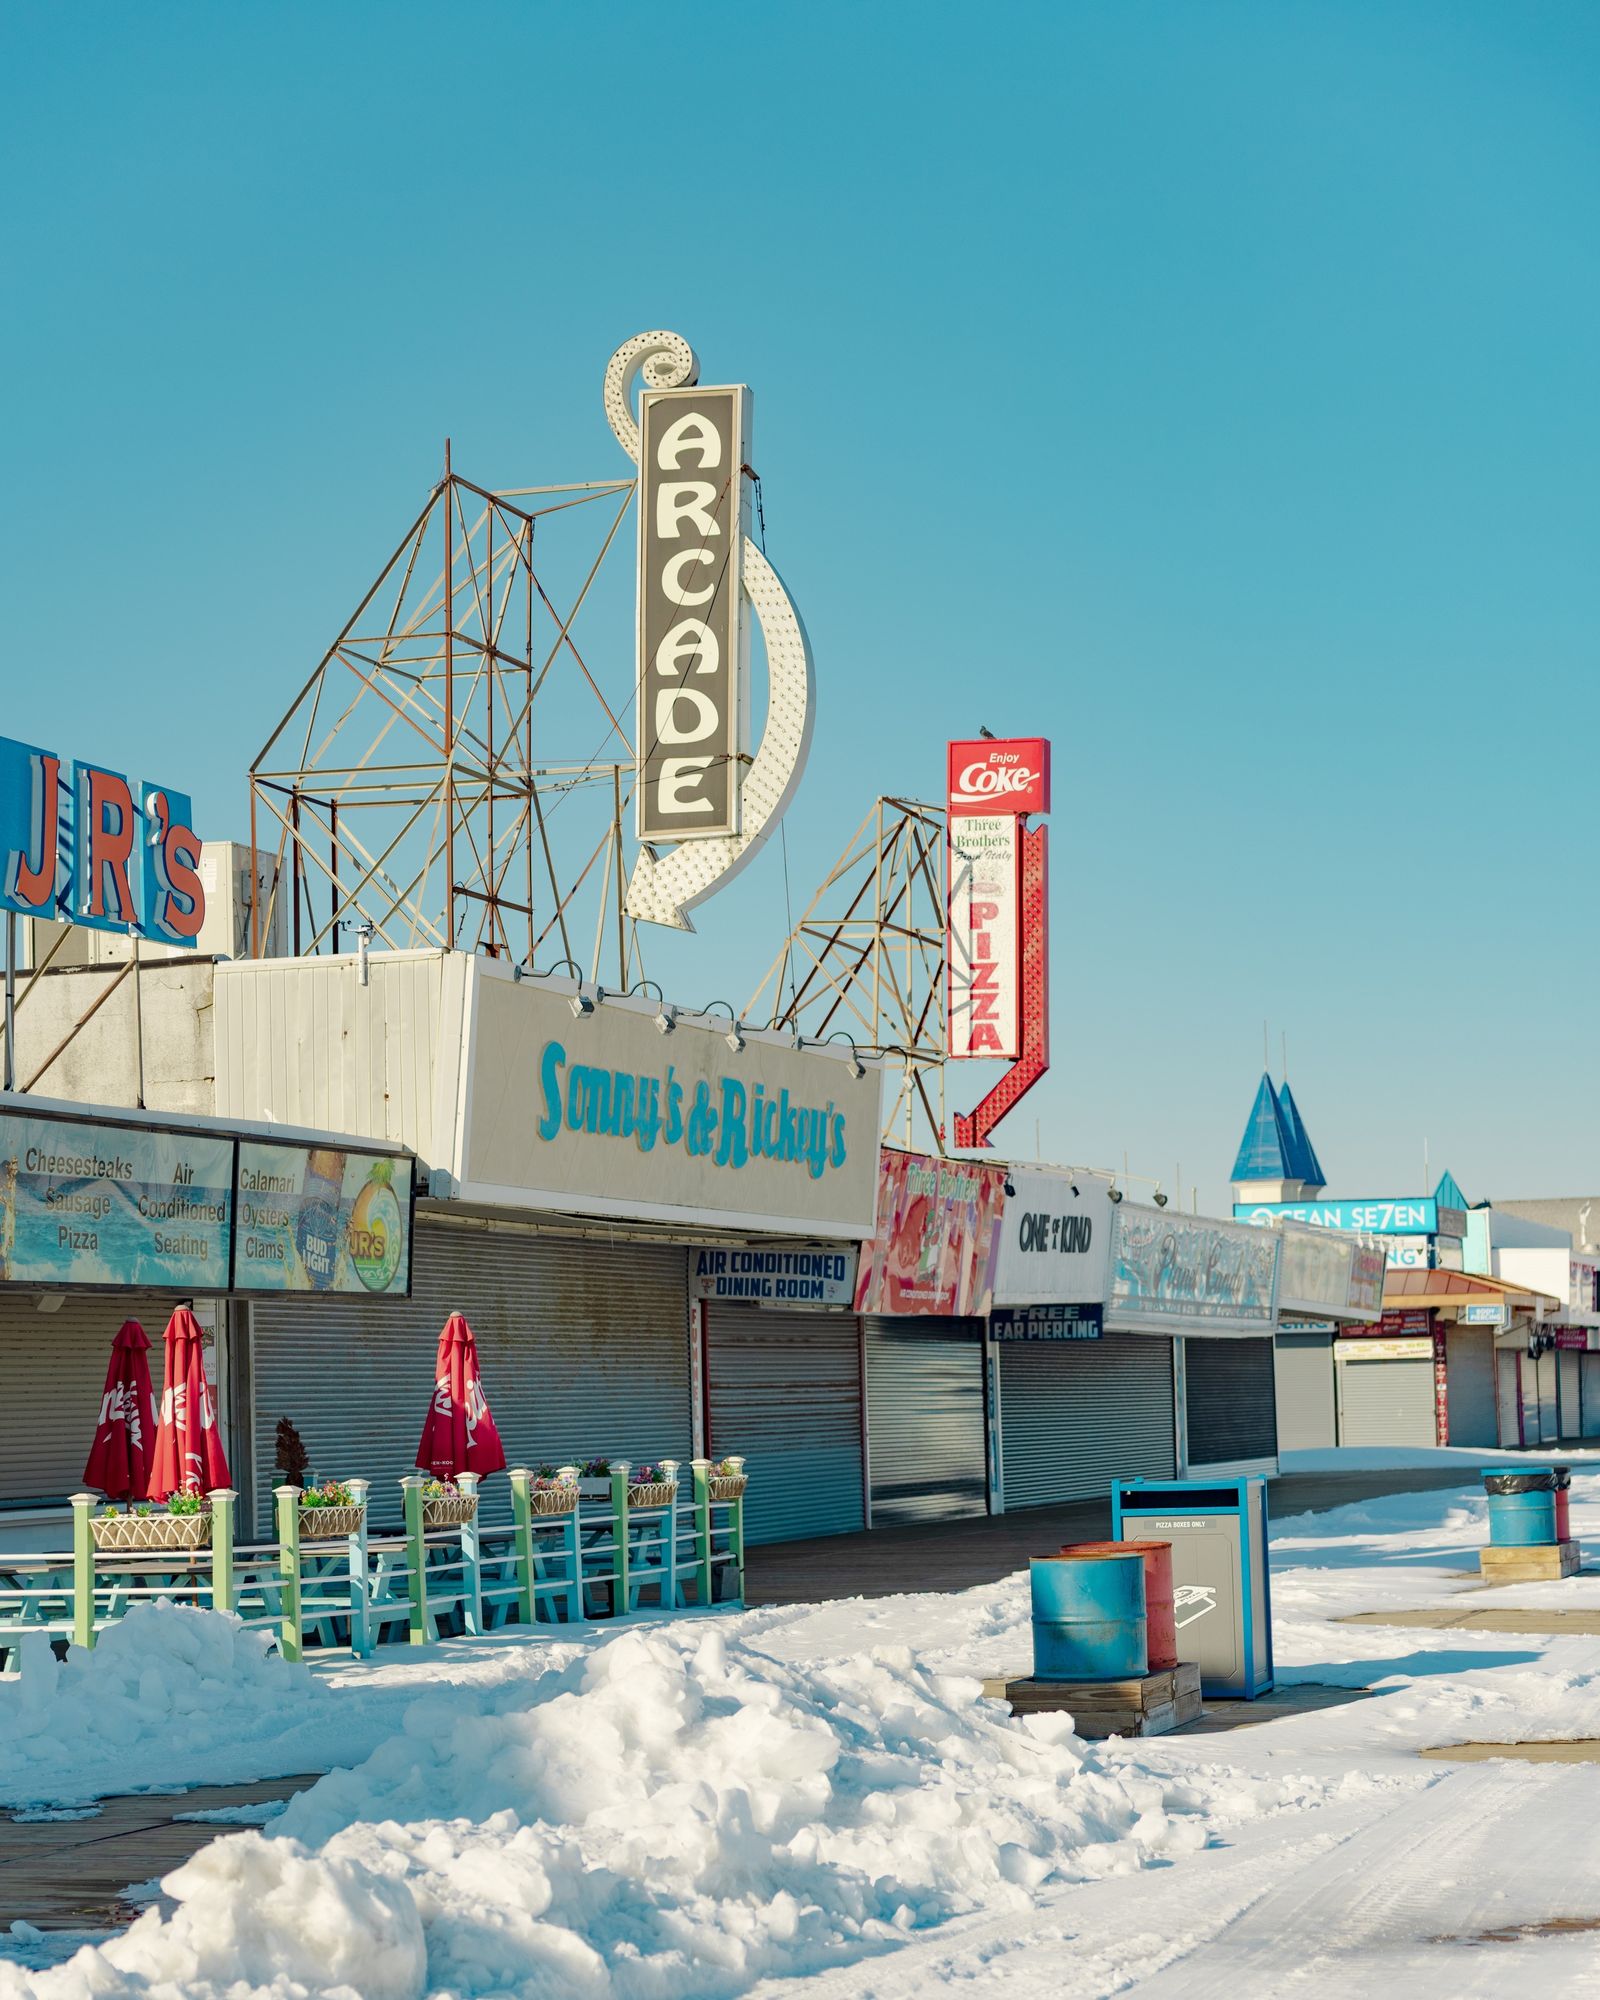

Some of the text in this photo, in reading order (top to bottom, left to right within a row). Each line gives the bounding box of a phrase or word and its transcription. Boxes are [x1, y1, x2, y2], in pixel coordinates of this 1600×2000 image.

[656, 411, 722, 815] ARCADE
[989, 753, 1020, 764] Enjoy
[959, 762, 1040, 793] Coke
[965, 818, 1001, 831] Three
[957, 834, 1010, 848] Brothers
[966, 902, 1003, 1051] PIZZA
[537, 1040, 846, 1180] Sonny's & Rickey's
[25, 1147, 133, 1179] Cheesesteaks
[173, 1162, 194, 1184] Air
[240, 1168, 295, 1193] Calamari
[907, 1163, 936, 1197] Three
[45, 1186, 111, 1219] Sausage
[138, 1194, 226, 1222] Conditioned
[242, 1203, 289, 1230] Oysters
[1351, 1203, 1425, 1230] SE7EN
[58, 1225, 98, 1250] Pizza
[306, 1234, 328, 1257] BUD
[1019, 1212, 1050, 1252] ONE
[1060, 1215, 1092, 1253] KIND
[154, 1231, 208, 1261] Seating
[246, 1237, 284, 1260] Clams
[1387, 1247, 1416, 1265] NG
[302, 1250, 330, 1274] LIGHT
[696, 1251, 845, 1281] AIR CONDITIONED
[716, 1277, 772, 1297] DINING
[775, 1279, 824, 1299] ROOM
[1013, 1306, 1079, 1320] FREE
[994, 1320, 1098, 1340] EAR PIERCING
